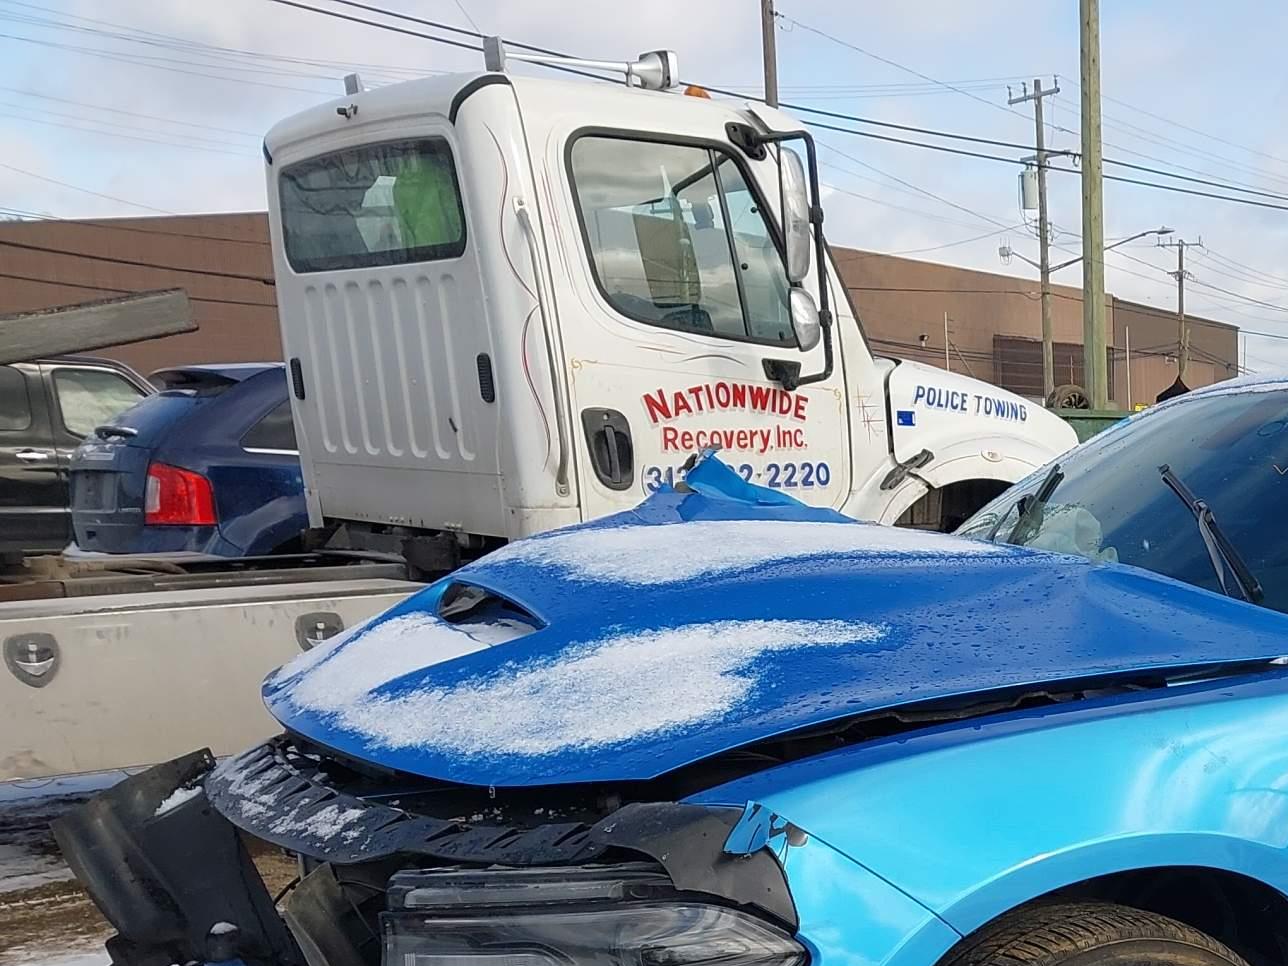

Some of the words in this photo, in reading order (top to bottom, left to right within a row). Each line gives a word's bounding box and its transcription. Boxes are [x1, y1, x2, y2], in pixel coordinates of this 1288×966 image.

[643, 382, 809, 423] NATIONWIDE
[914, 385, 968, 411] POLICE
[974, 395, 1027, 421] TOWING
[777, 425, 808, 448] Inc.
